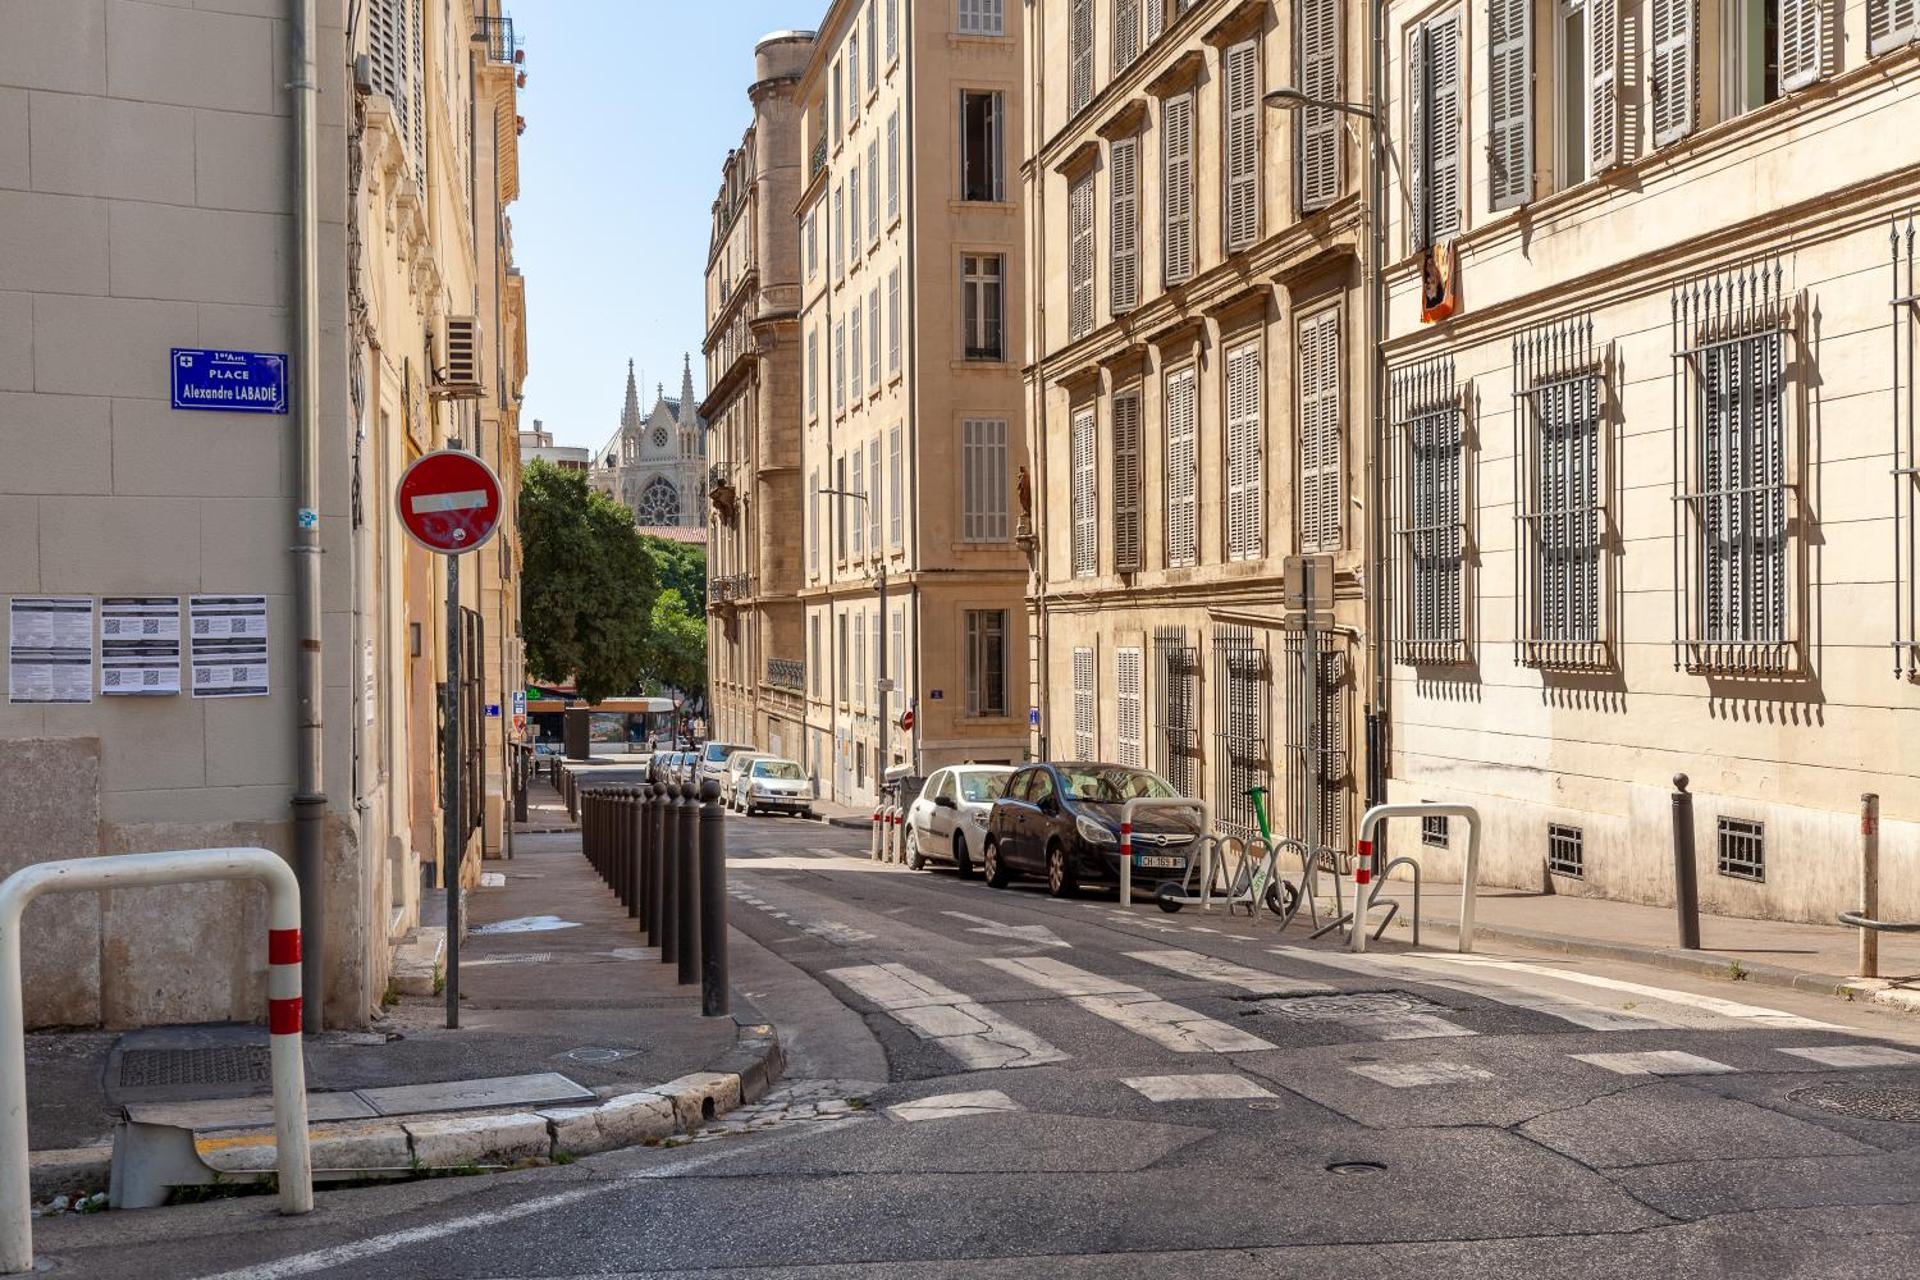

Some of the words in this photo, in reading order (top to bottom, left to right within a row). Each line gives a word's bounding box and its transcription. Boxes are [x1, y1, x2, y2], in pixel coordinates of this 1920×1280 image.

[209, 369, 249, 380] PLACE
[183, 384, 233, 400] Alexandre
[235, 384, 277, 401] LABADIÉ
